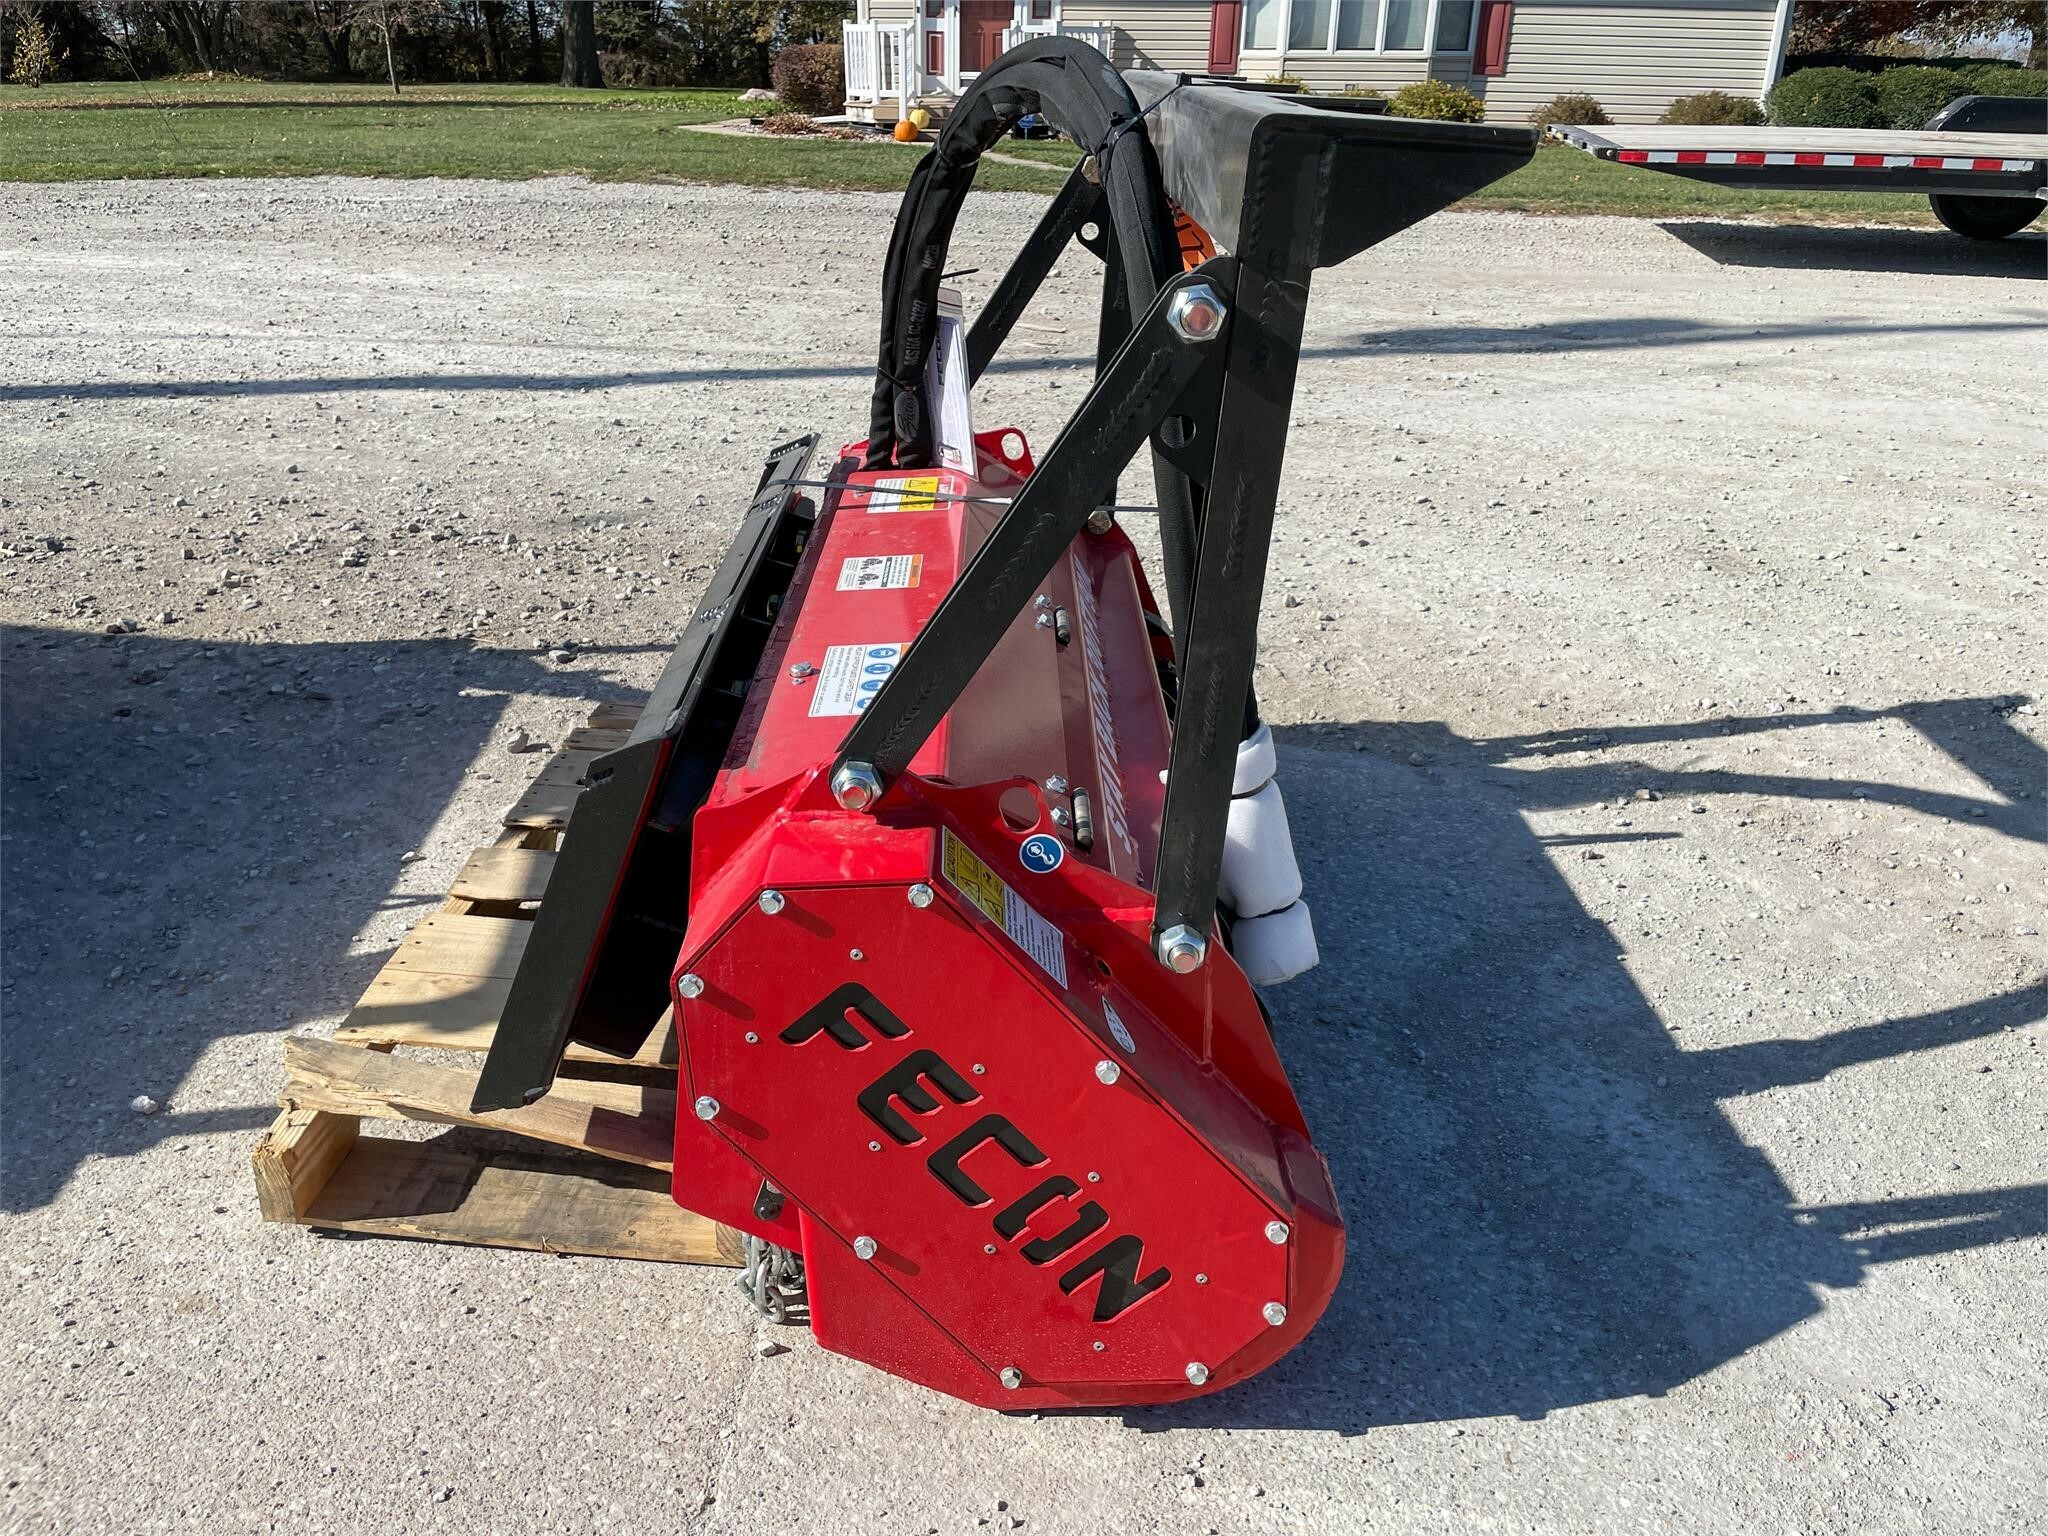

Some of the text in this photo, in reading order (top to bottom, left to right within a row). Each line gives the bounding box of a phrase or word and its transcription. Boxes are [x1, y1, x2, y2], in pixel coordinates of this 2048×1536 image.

[904, 336, 921, 366] MSHA
[1098, 738, 1132, 856] STAY
[777, 981, 1172, 1324] FECON
